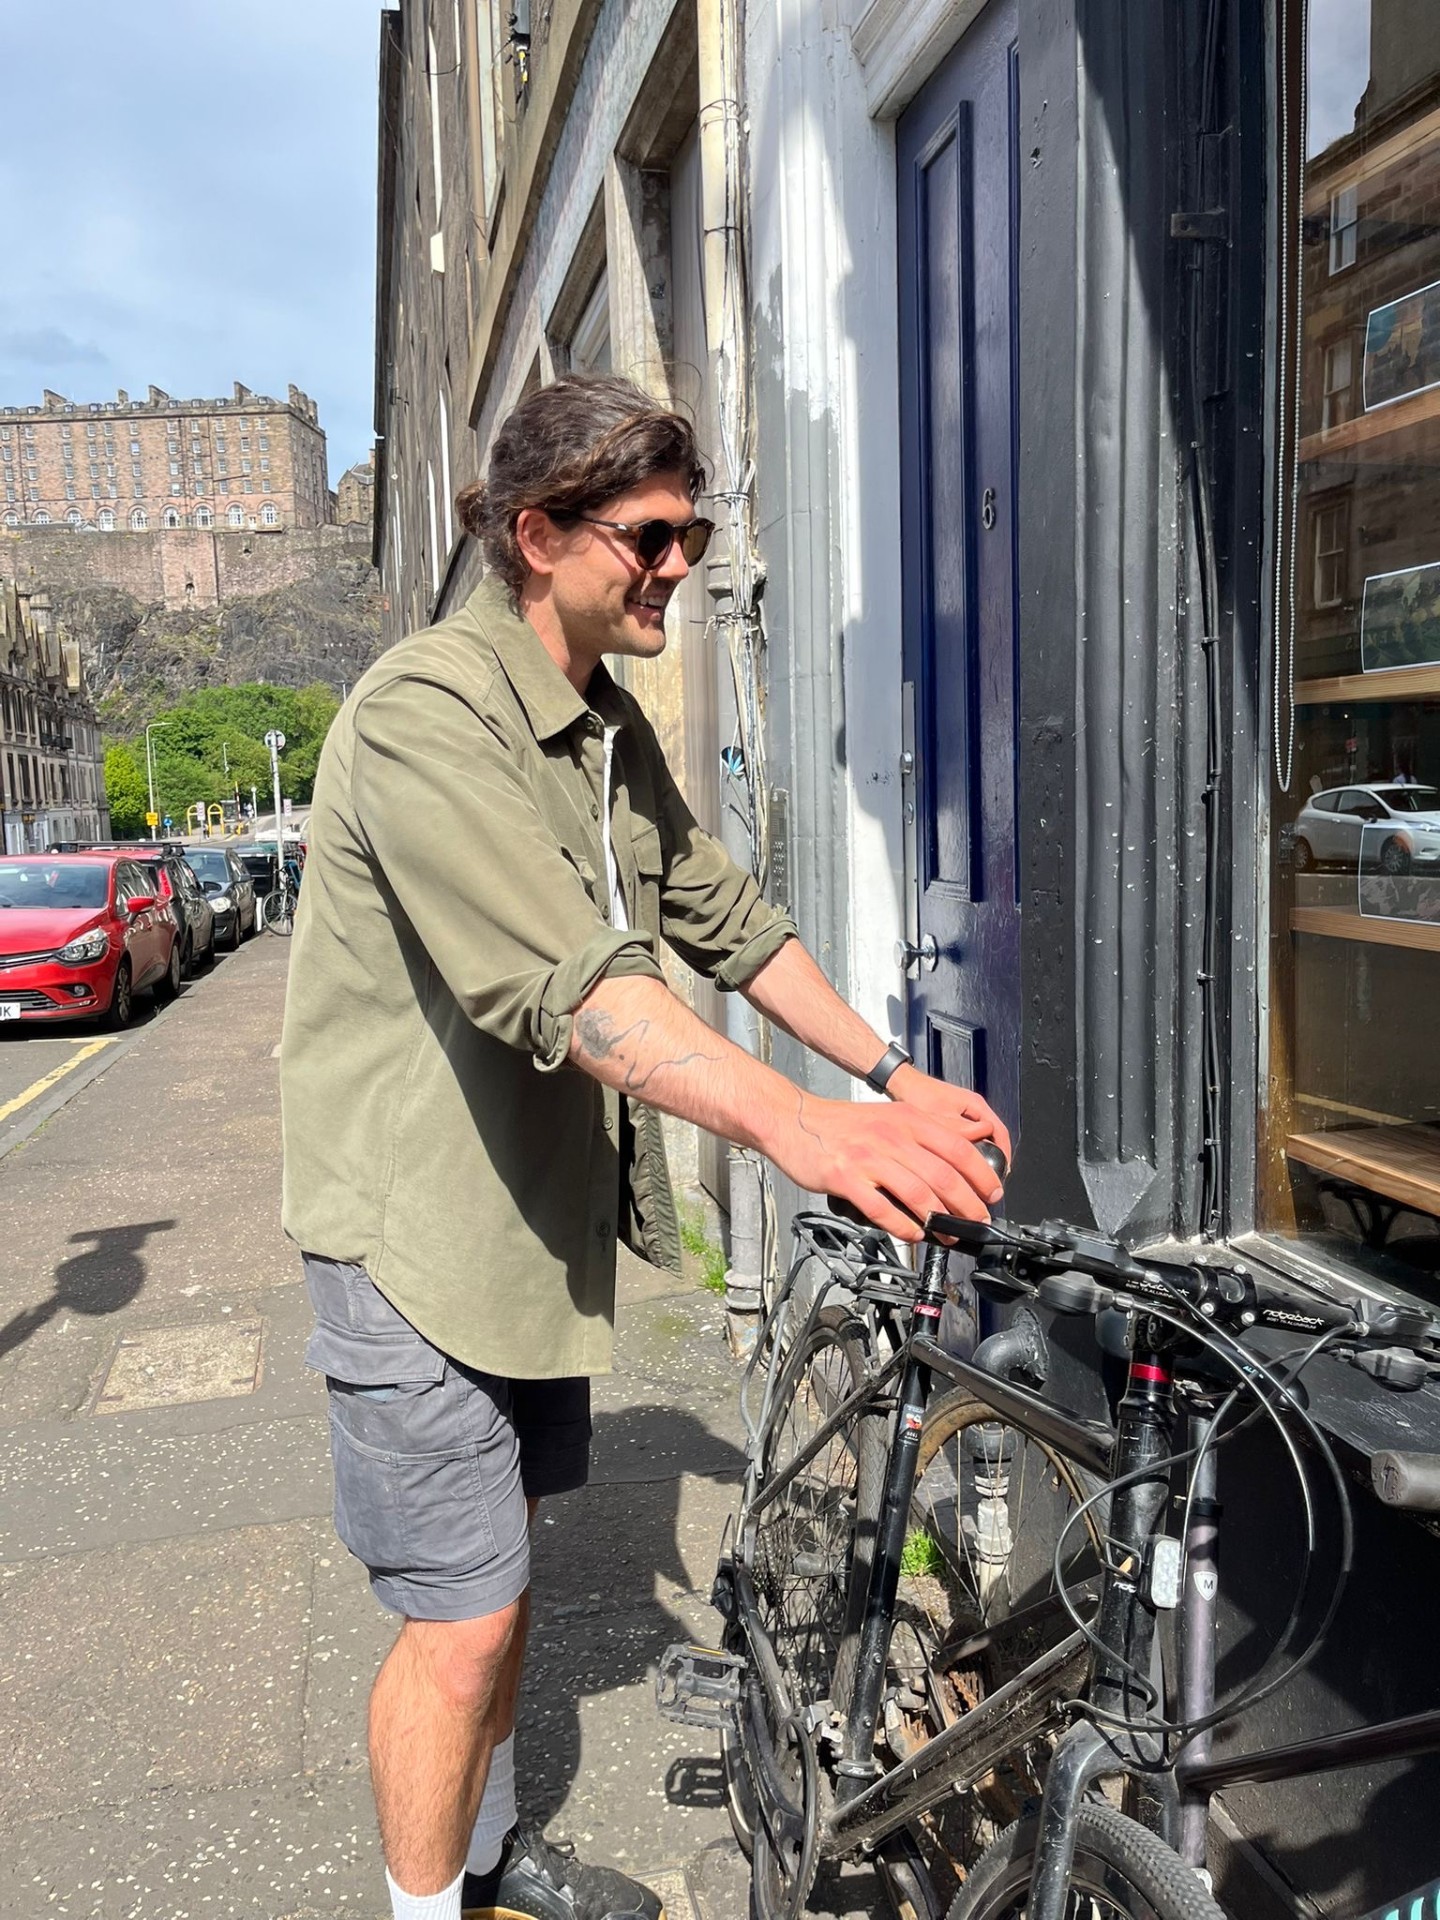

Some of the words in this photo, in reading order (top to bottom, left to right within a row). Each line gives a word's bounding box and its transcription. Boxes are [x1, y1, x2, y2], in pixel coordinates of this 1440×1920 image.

[982, 488, 996, 530] 6
[1263, 1309, 1325, 1326] ridgeback
[1203, 1579, 1214, 1591] M
